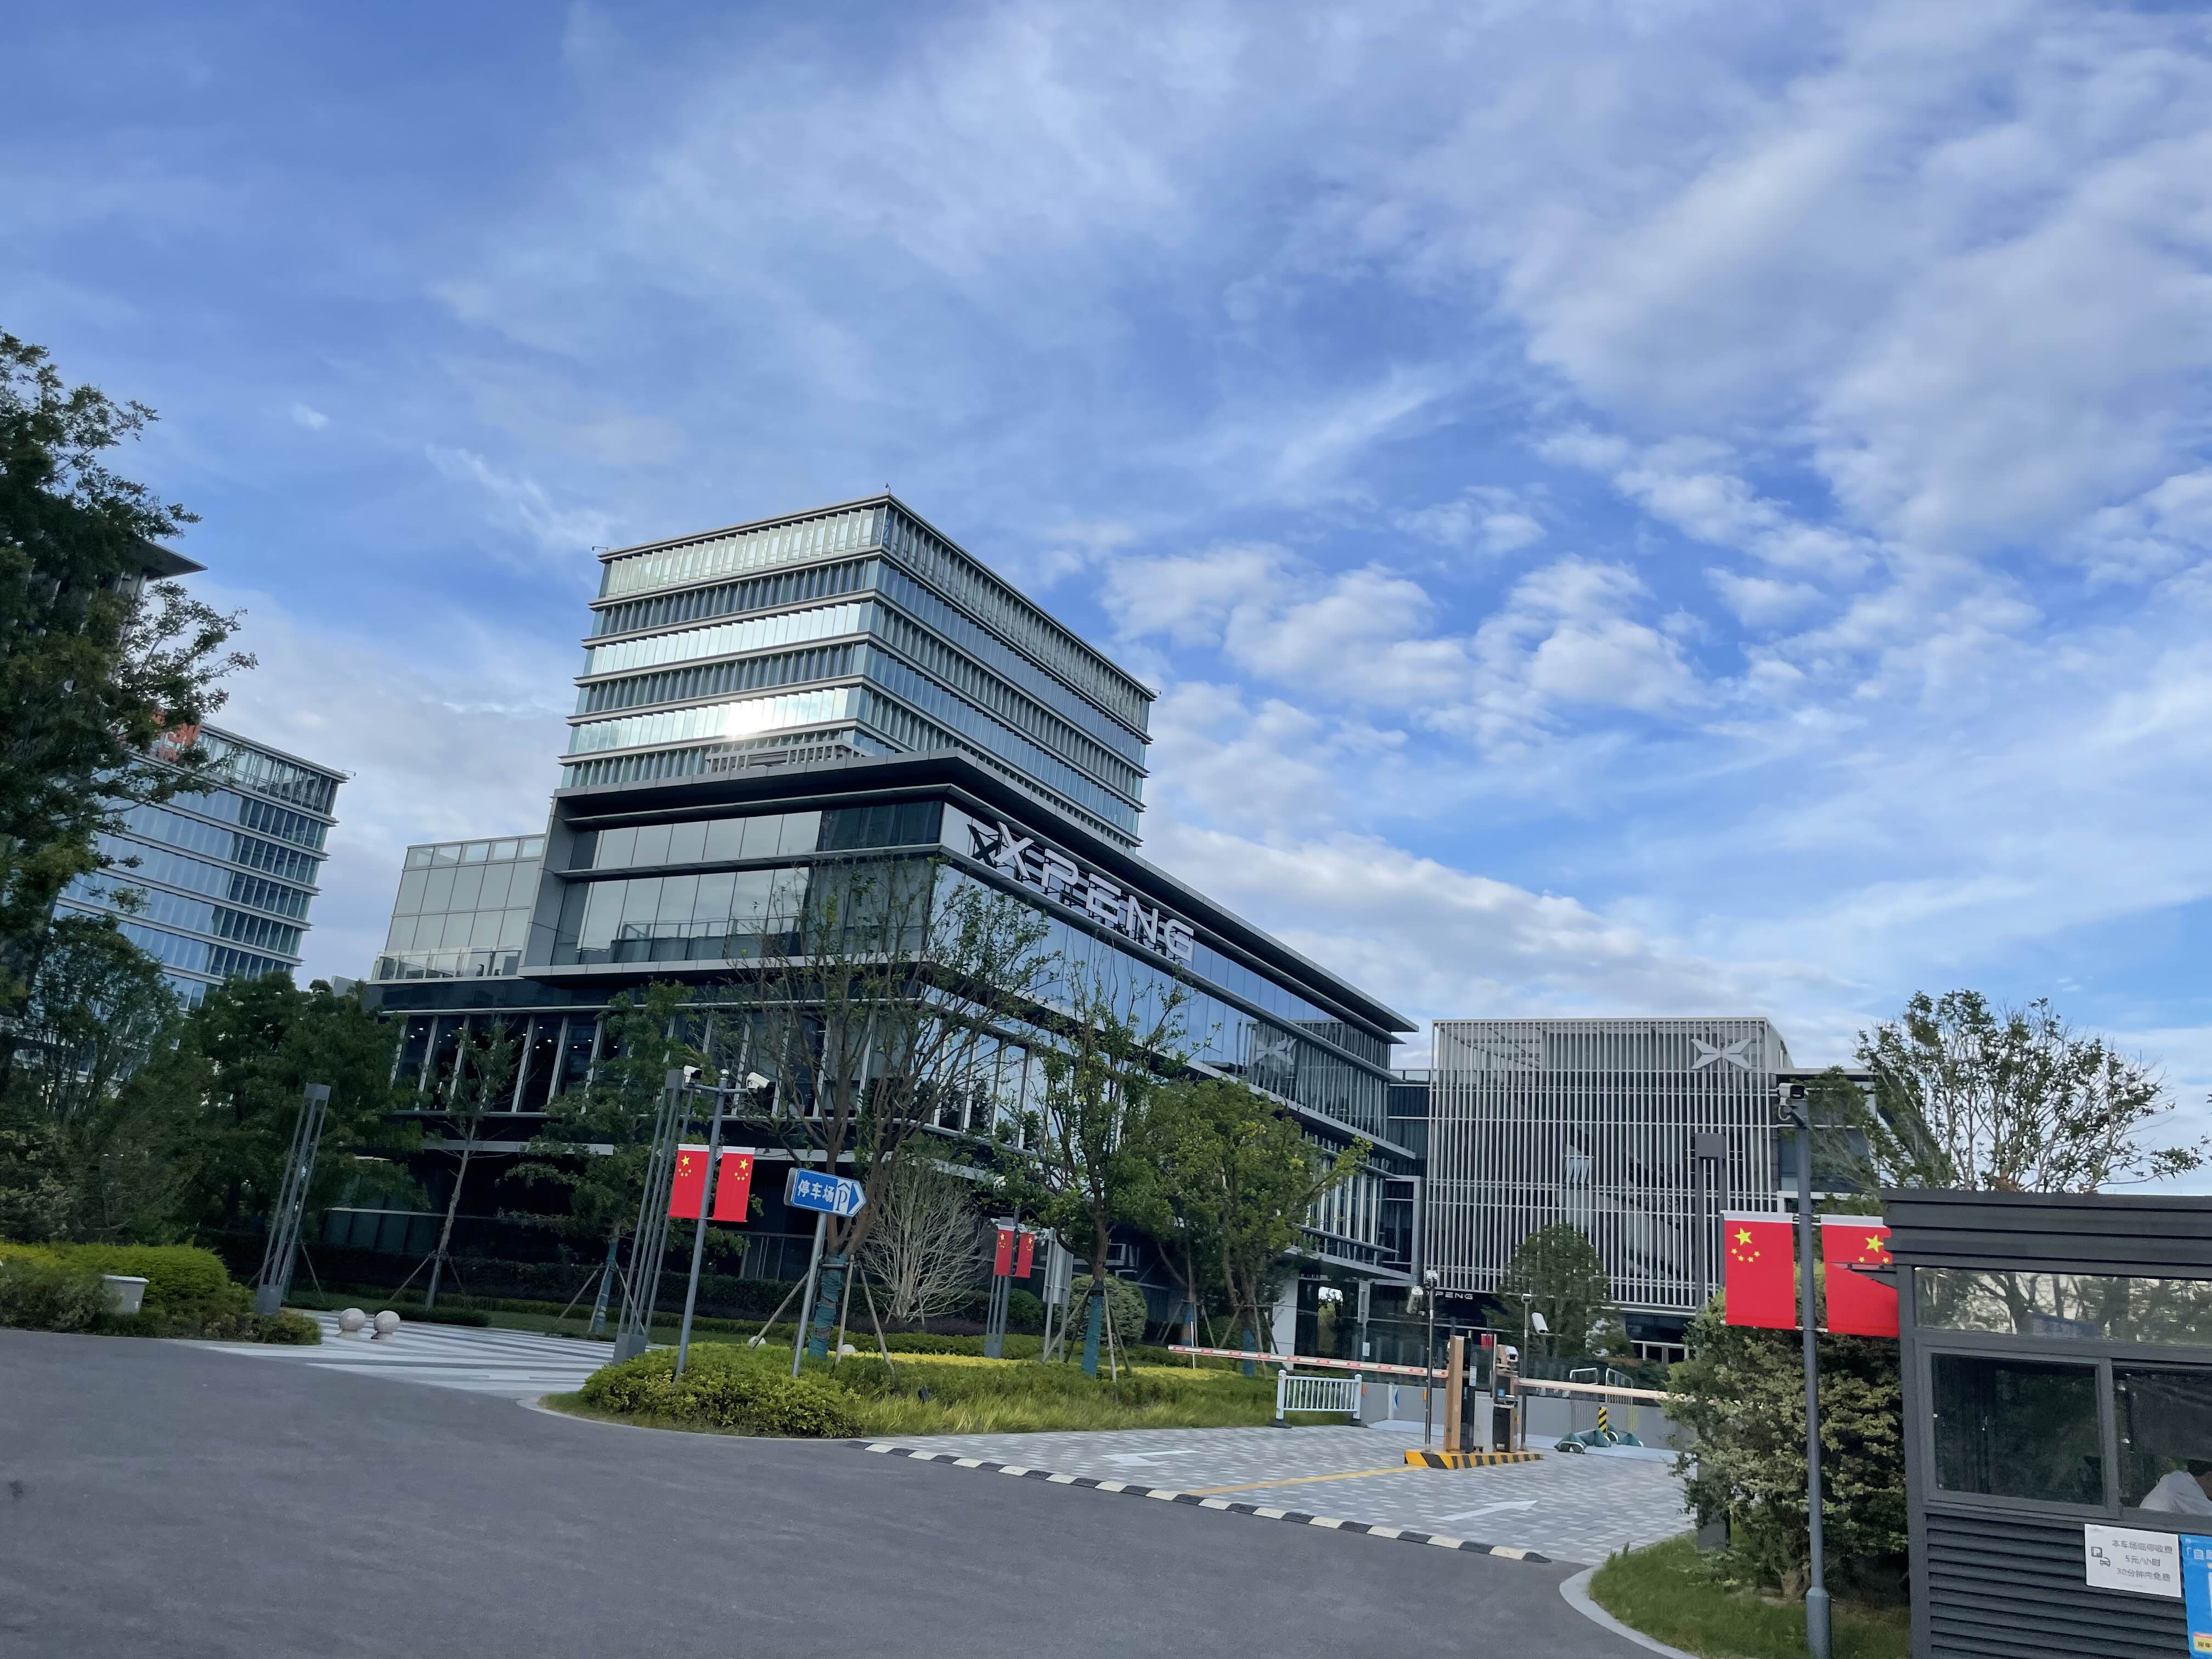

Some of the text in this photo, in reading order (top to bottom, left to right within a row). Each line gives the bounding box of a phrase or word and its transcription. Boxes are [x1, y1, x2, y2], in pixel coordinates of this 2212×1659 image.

[994, 821, 1194, 962] XPENG
[798, 1179, 848, 1211] 停车场 P
